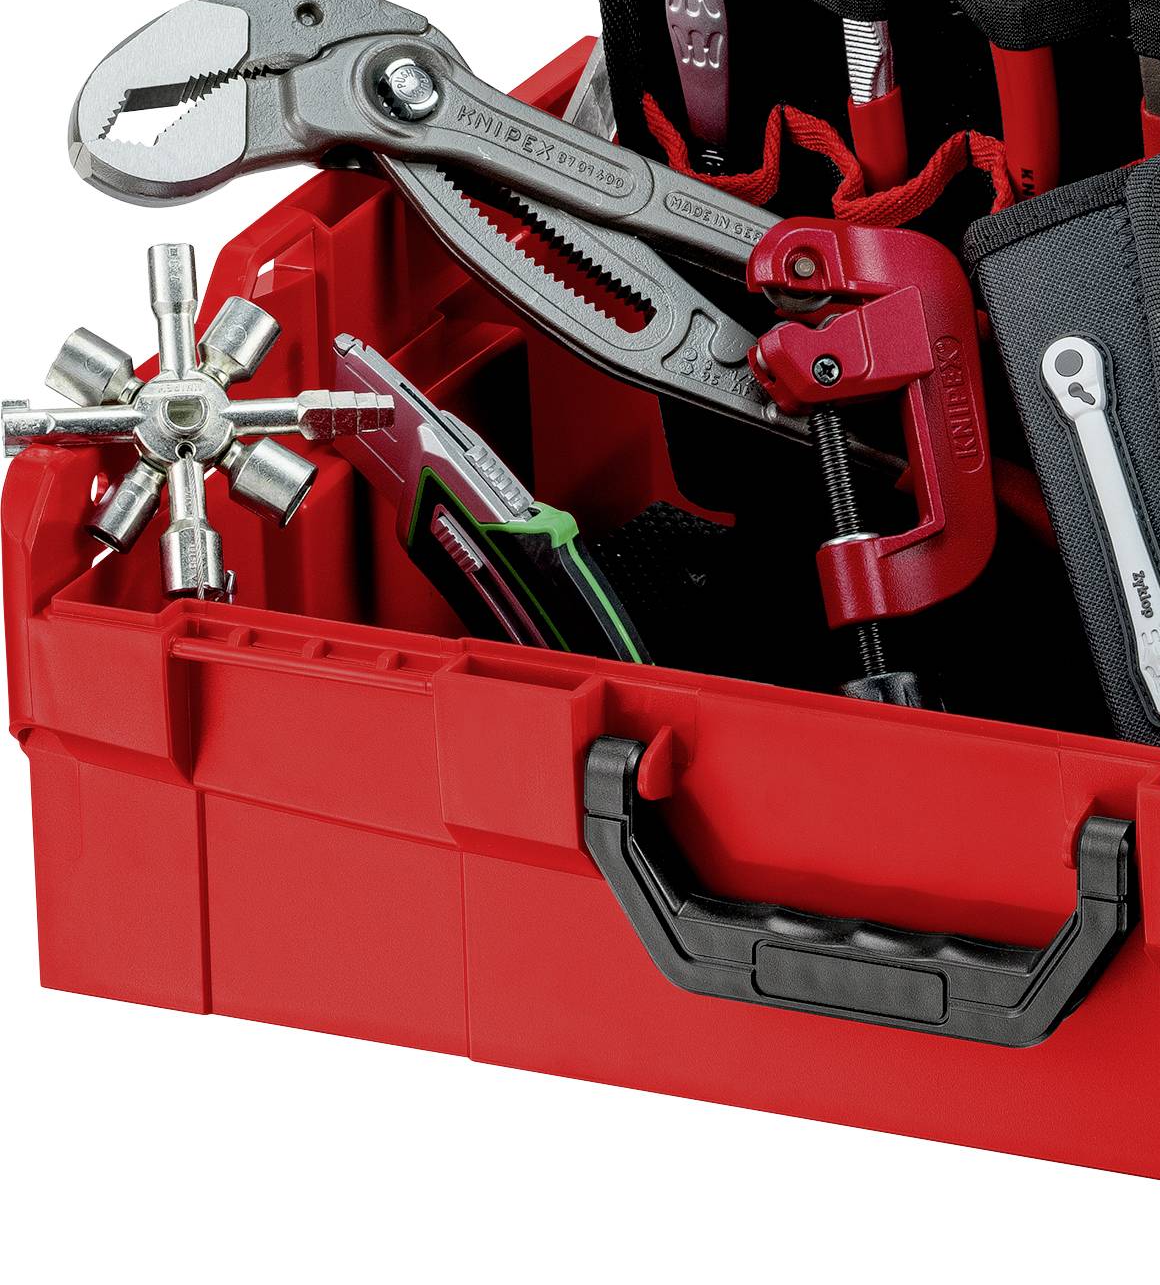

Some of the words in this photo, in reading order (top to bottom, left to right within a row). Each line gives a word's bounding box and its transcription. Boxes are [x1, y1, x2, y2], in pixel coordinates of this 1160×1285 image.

[456, 105, 555, 162] KNIPEX
[670, 196, 712, 221] MADE
[712, 210, 731, 228] IN
[936, 350, 978, 459] KNIPEX
[1132, 569, 1154, 619] Zyklop
